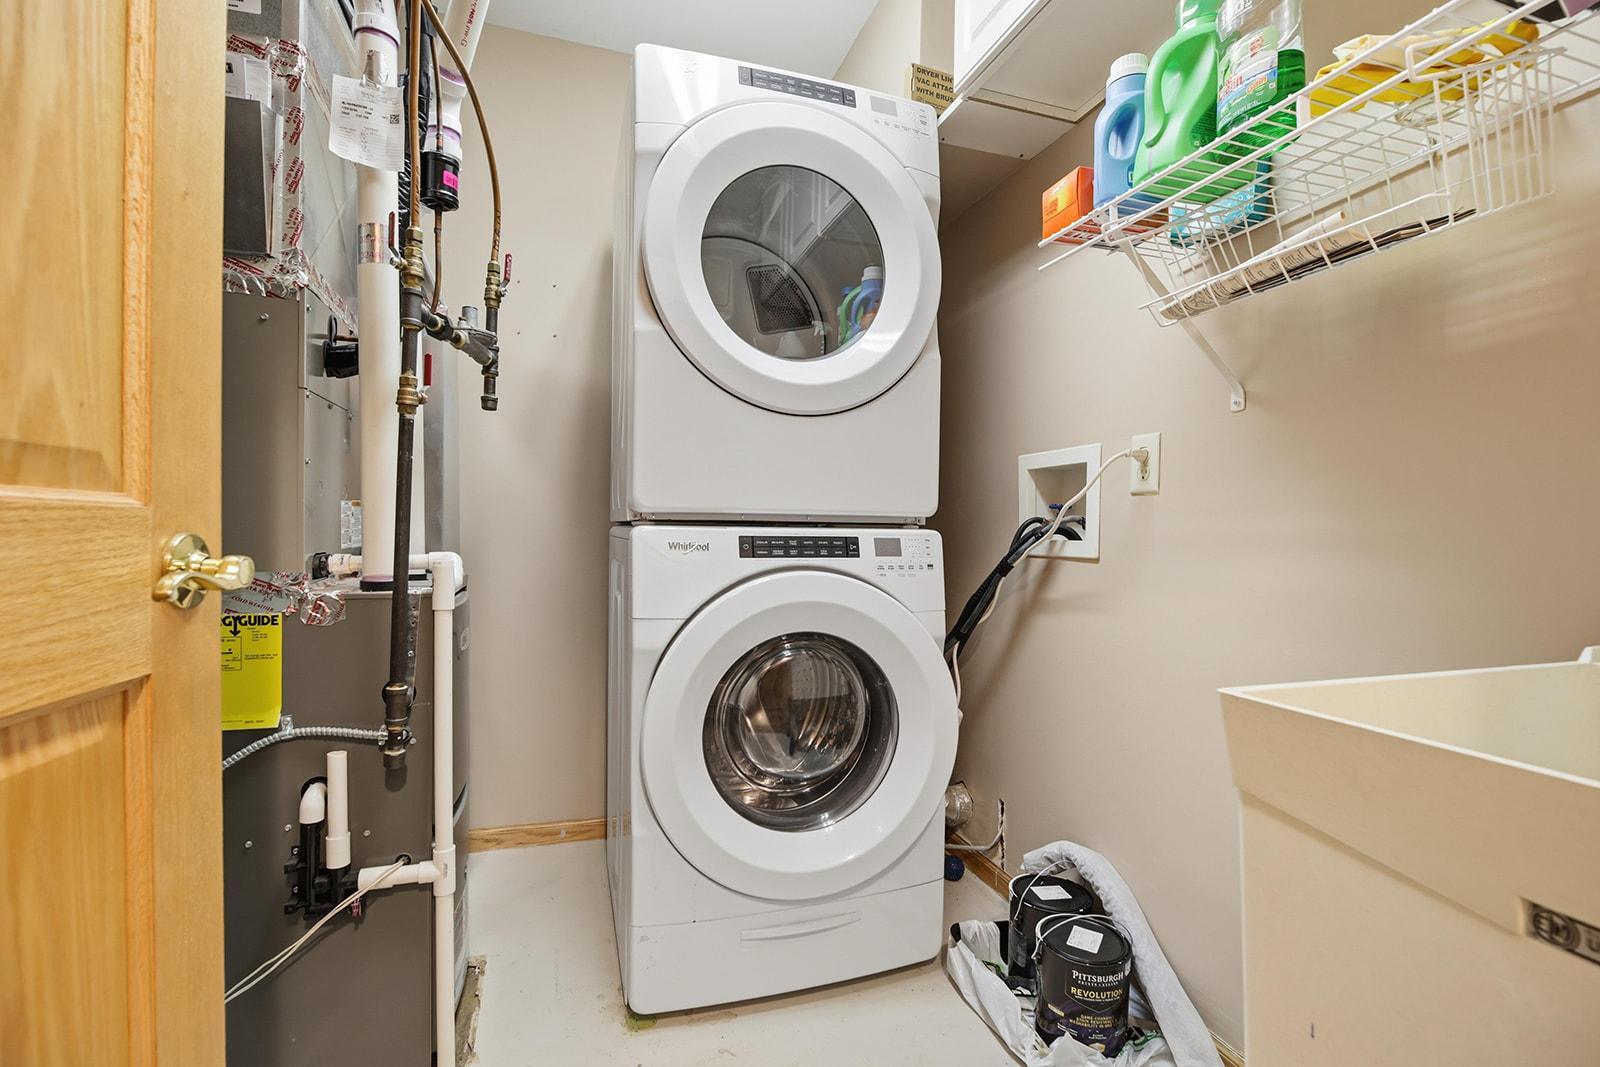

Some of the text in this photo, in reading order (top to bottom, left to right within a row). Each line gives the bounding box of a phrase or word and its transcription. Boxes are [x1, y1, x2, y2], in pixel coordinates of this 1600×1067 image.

[916, 67, 940, 80] DRYER
[916, 76, 930, 86] VAC
[916, 86, 934, 97] WITH
[668, 541, 710, 554] Whirlpool
[221, 614, 279, 626] GYGUIDE
[1071, 969, 1124, 983] PITTSBURGH
[1070, 986, 1123, 999] REVOLUTION
